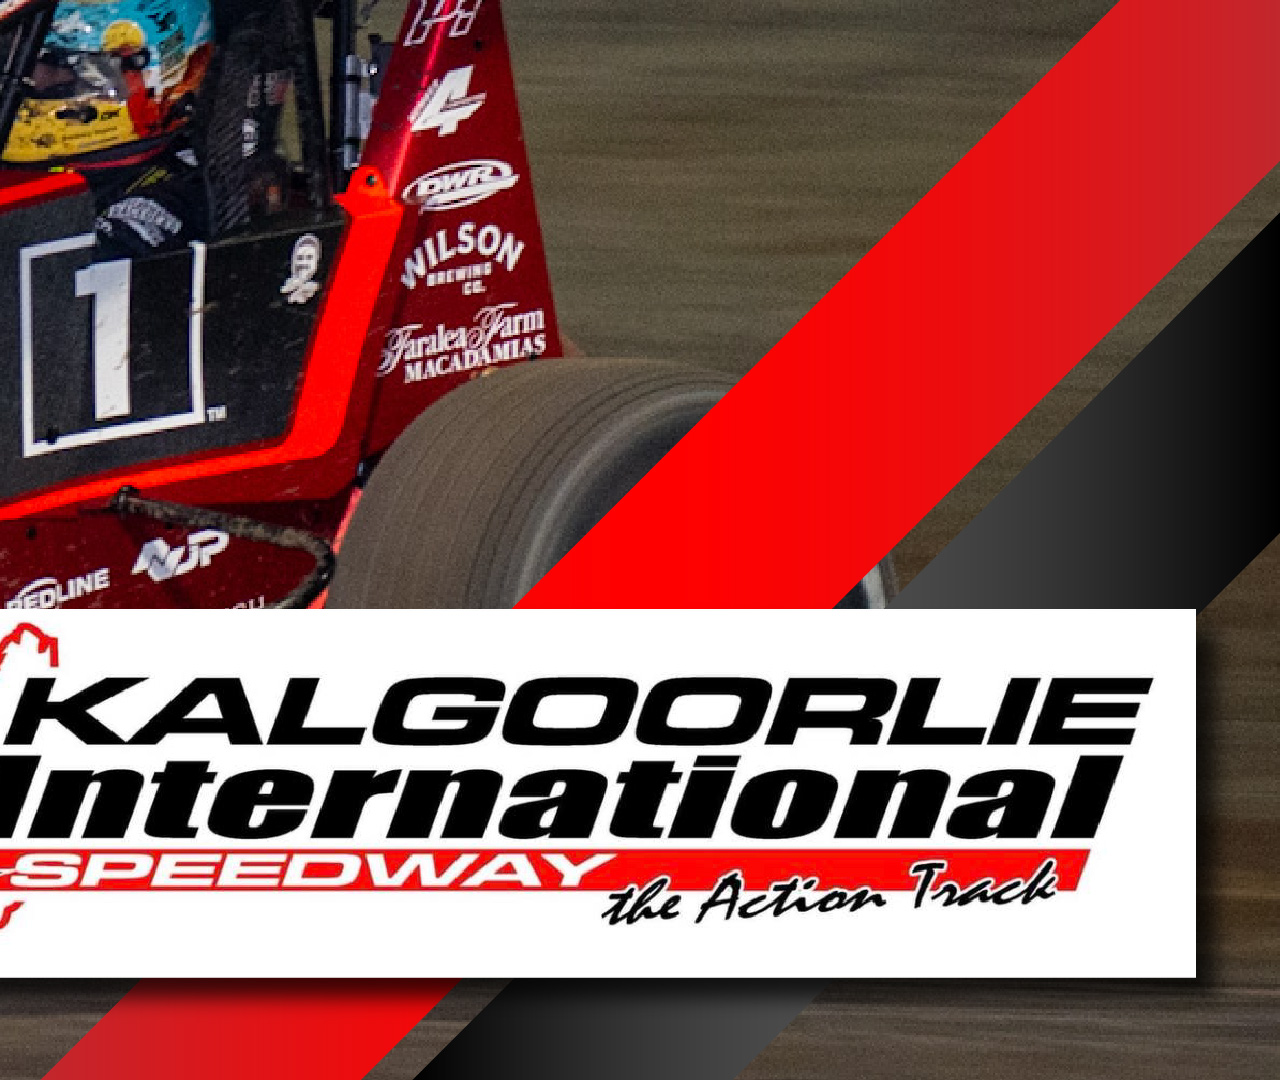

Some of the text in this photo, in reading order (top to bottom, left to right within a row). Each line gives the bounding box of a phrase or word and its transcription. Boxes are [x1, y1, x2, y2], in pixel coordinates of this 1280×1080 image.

[401, 221, 526, 290] WILSON
[74, 259, 133, 423] 1
[403, 333, 547, 384] MACADAMIAS
